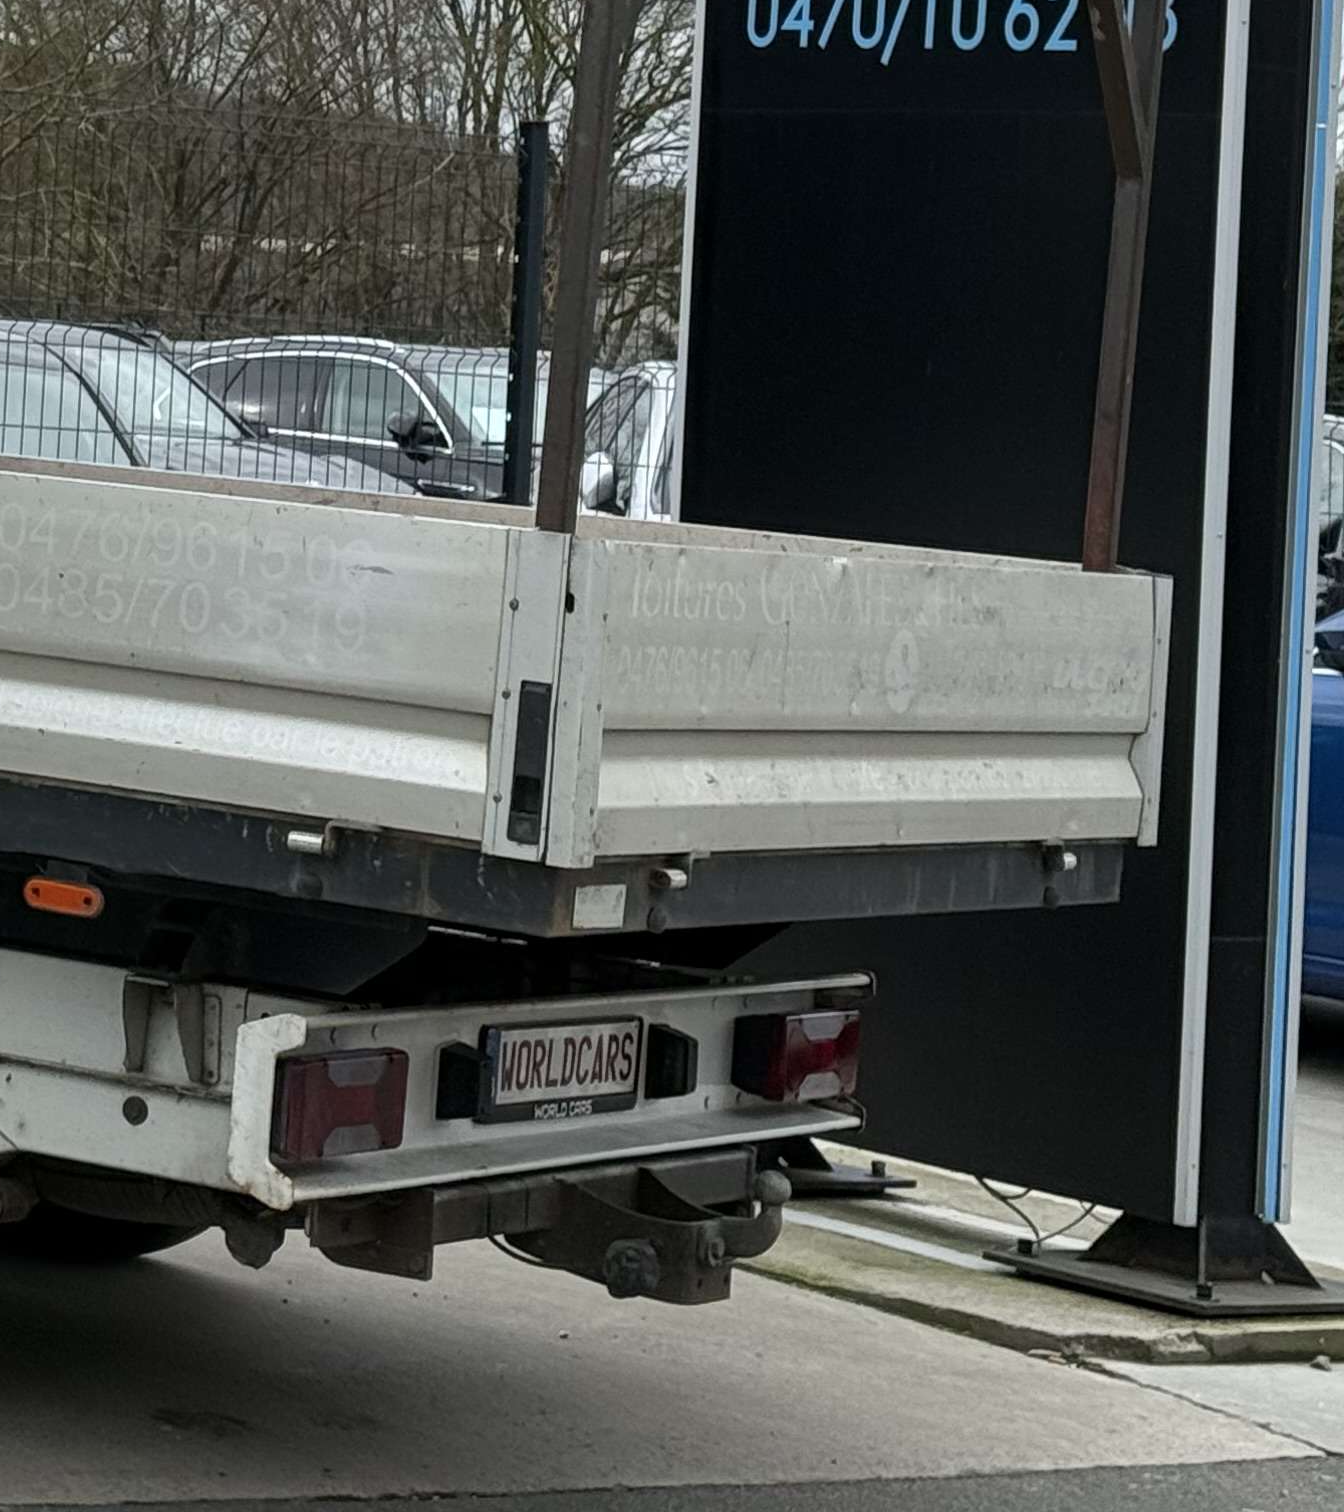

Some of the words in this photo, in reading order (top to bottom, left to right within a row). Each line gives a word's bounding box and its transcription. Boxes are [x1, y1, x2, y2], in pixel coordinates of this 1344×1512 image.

[500, 1031, 634, 1092] WORLDCARS
[534, 1102, 568, 1120] WORLD
[568, 1099, 593, 1117] CARS
